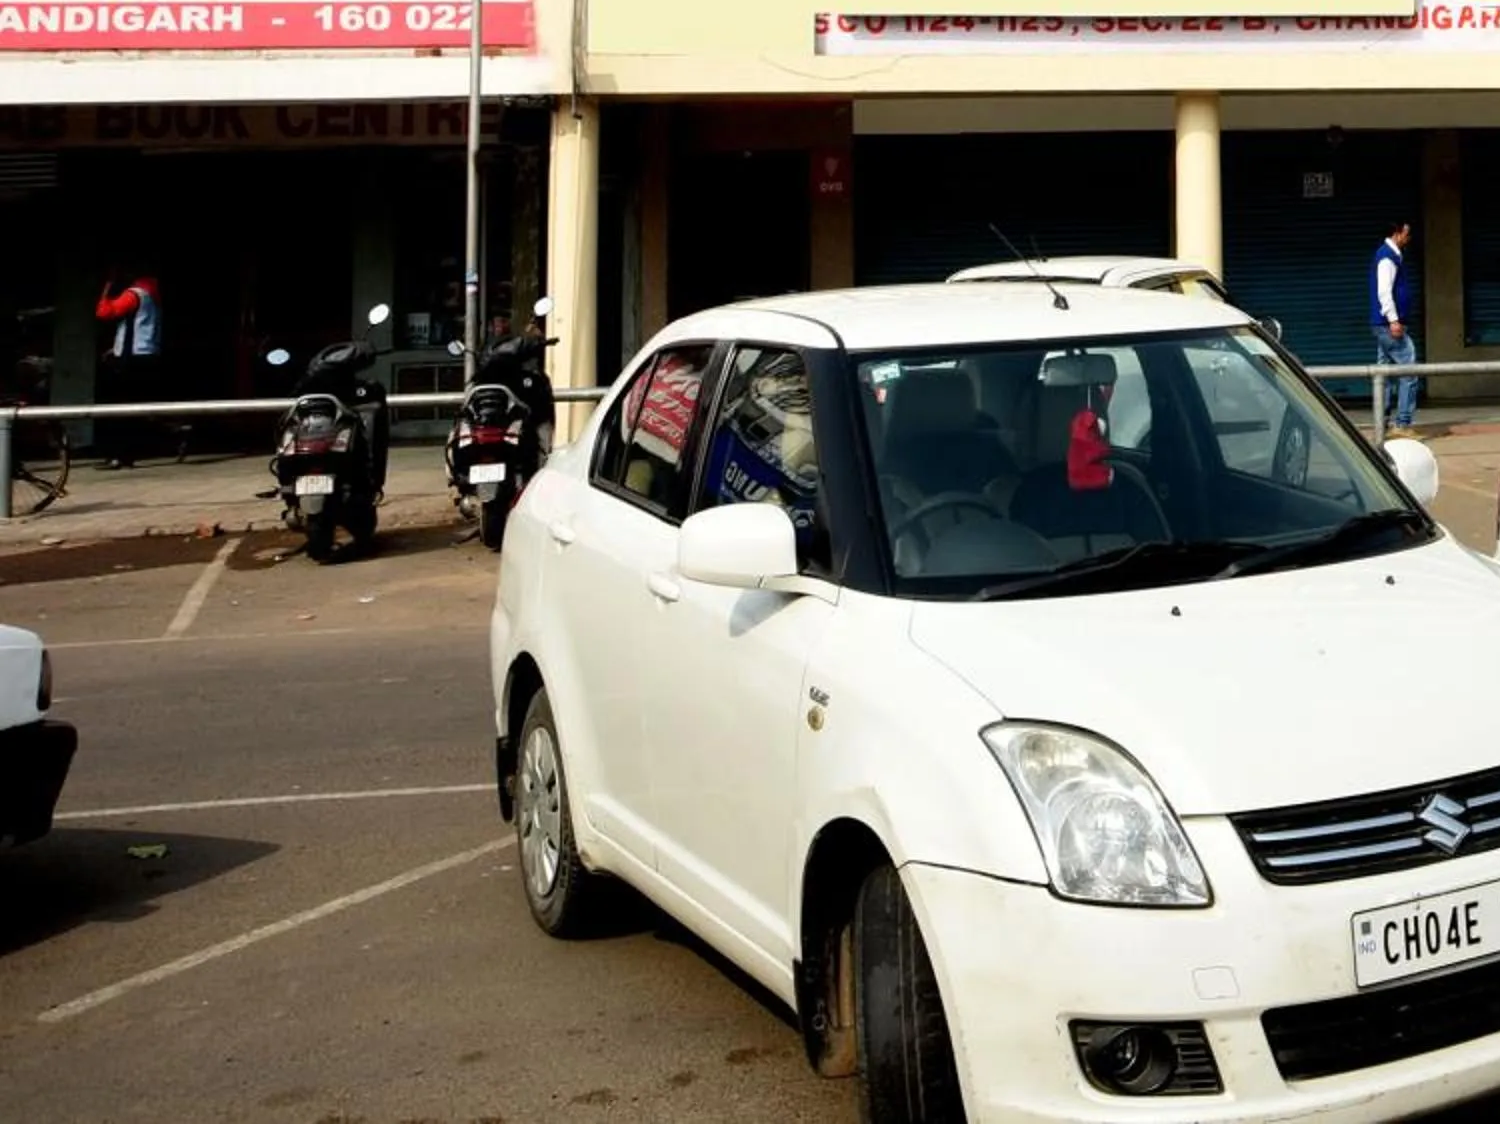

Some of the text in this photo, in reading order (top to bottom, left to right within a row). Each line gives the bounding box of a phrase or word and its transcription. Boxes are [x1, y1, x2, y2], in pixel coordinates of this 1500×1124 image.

[0, 5, 243, 32] ANDIGARH
[314, 5, 391, 31] 160
[1383, 901, 1482, 964] CH04E
